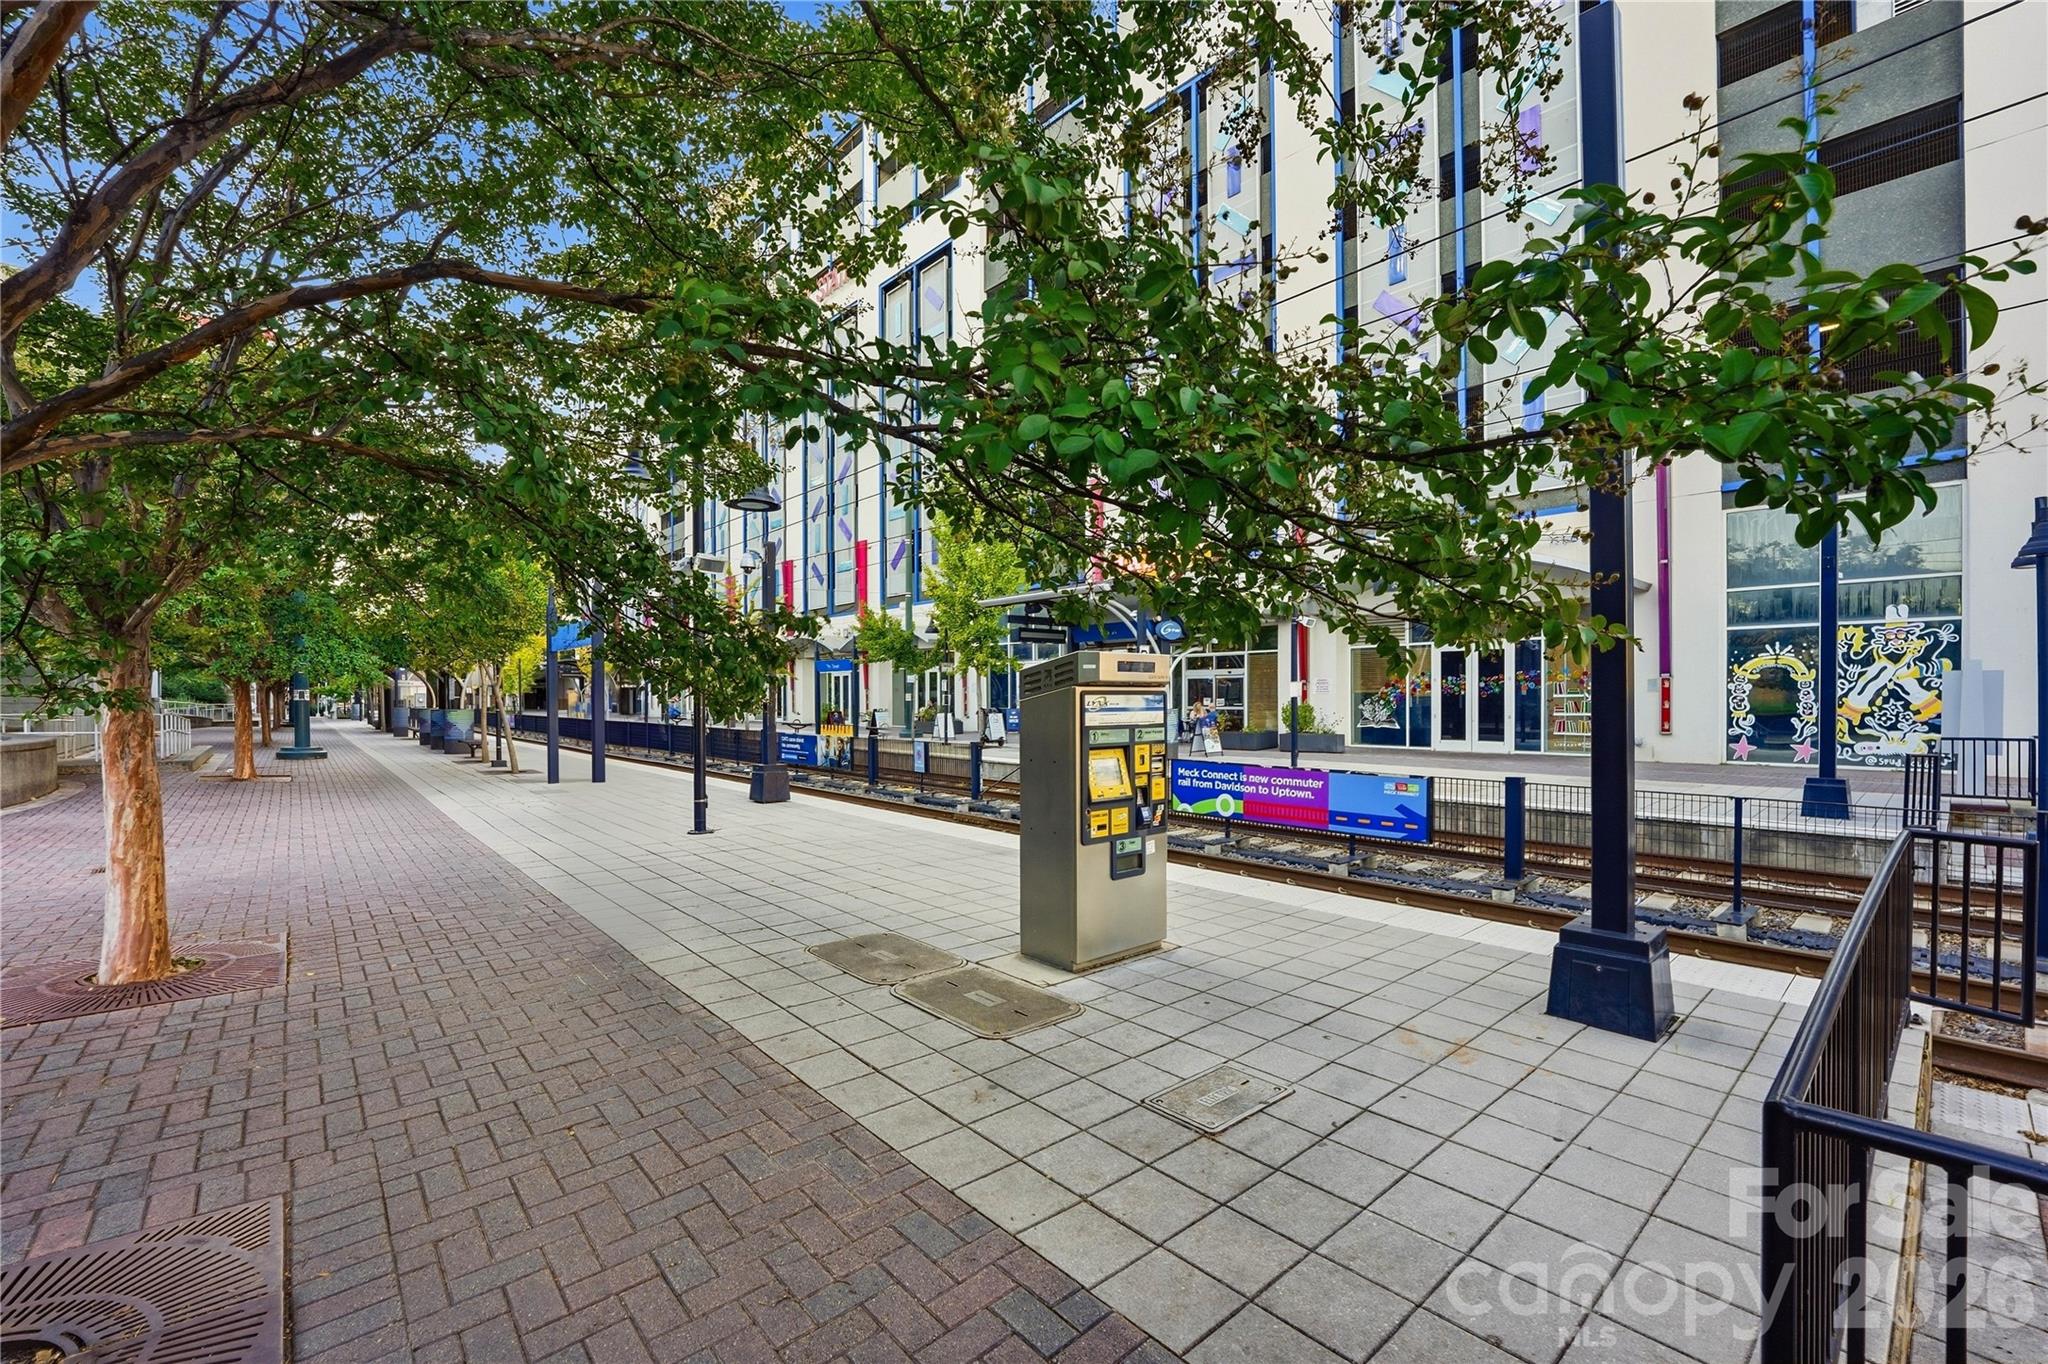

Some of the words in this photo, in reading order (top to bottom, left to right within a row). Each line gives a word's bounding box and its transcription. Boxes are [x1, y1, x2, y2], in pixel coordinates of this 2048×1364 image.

[1177, 767, 1199, 776] Meck
[1201, 769, 1238, 781] Connect
[1239, 772, 1247, 782] is
[1249, 775, 1269, 784] new
[1270, 776, 1325, 789] commuter
[1177, 777, 1191, 786] rail
[1192, 778, 1213, 789] from
[1214, 780, 1257, 793] Davidson
[1258, 784, 1269, 794] to
[1271, 785, 1315, 799] Uptown.
